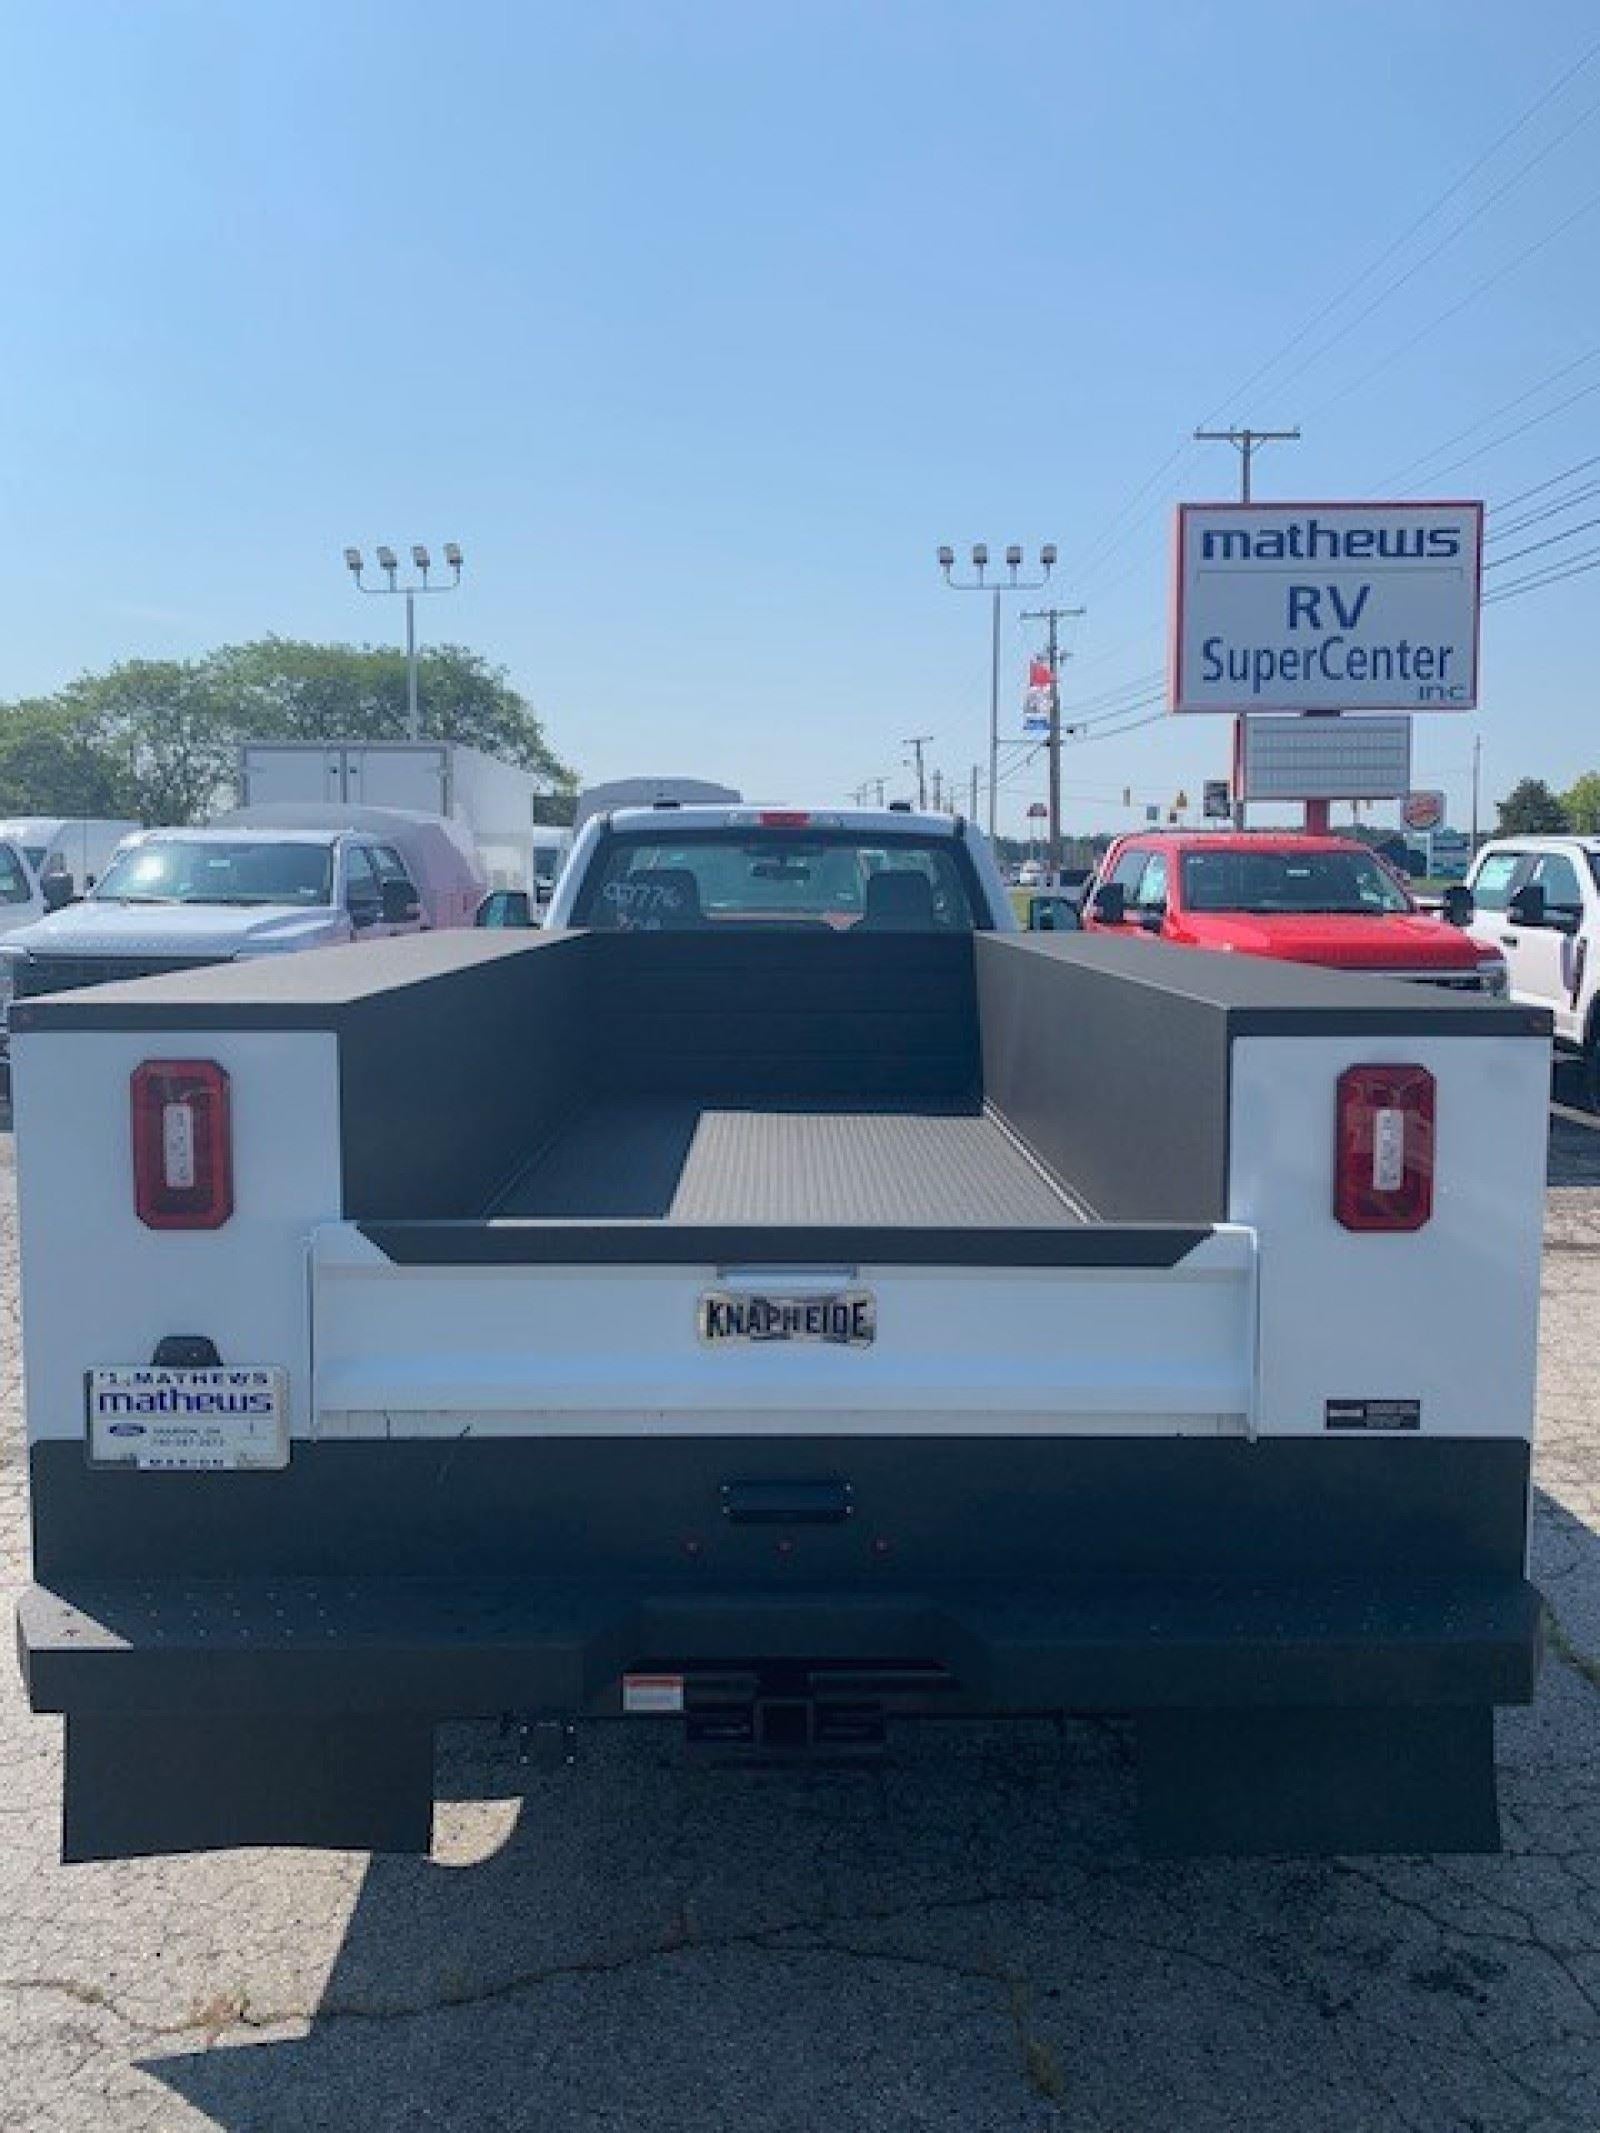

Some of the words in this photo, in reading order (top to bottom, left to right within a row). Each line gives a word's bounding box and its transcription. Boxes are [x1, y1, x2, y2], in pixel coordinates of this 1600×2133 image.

[1202, 520, 1460, 560] mathews
[1287, 583, 1370, 630] RV
[1202, 636, 1454, 694] SuperCenter
[706, 1299, 868, 1338] KNAPHEIDE
[100, 1388, 273, 1413] mathews
